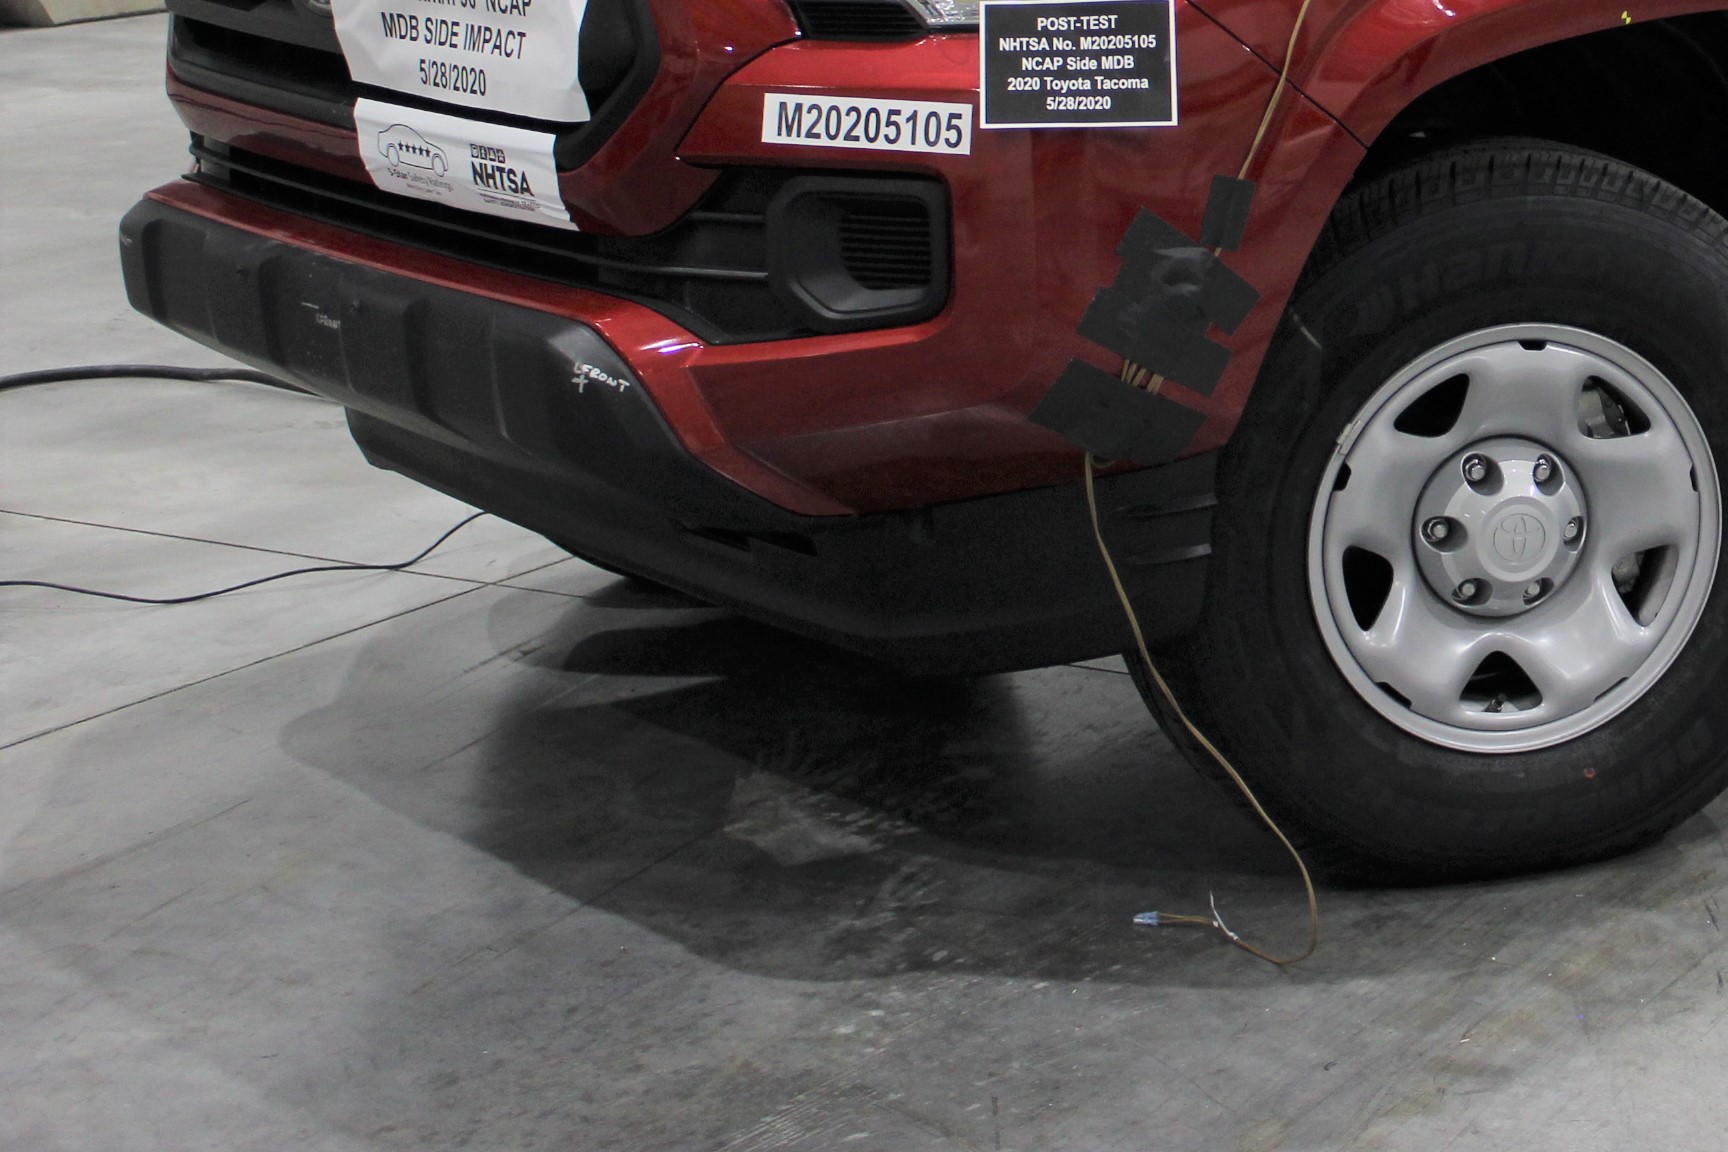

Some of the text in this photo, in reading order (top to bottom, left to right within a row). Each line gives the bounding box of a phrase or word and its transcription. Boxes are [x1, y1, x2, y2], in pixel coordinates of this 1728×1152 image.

[1037, 15, 1118, 30] POST-TEST
[381, 12, 526, 59] MDB SIDE IMPACT
[999, 35, 1157, 51] NHTSA No. M20205105
[1021, 55, 1135, 71] NCAP Side MDB
[419, 58, 487, 96] 5/28/2020
[1007, 76, 1149, 93] 2020 Toyota Tacoma
[1046, 96, 1111, 110] 5/28/2020
[776, 100, 963, 149] M20205105
[471, 160, 536, 196] NHTSA
